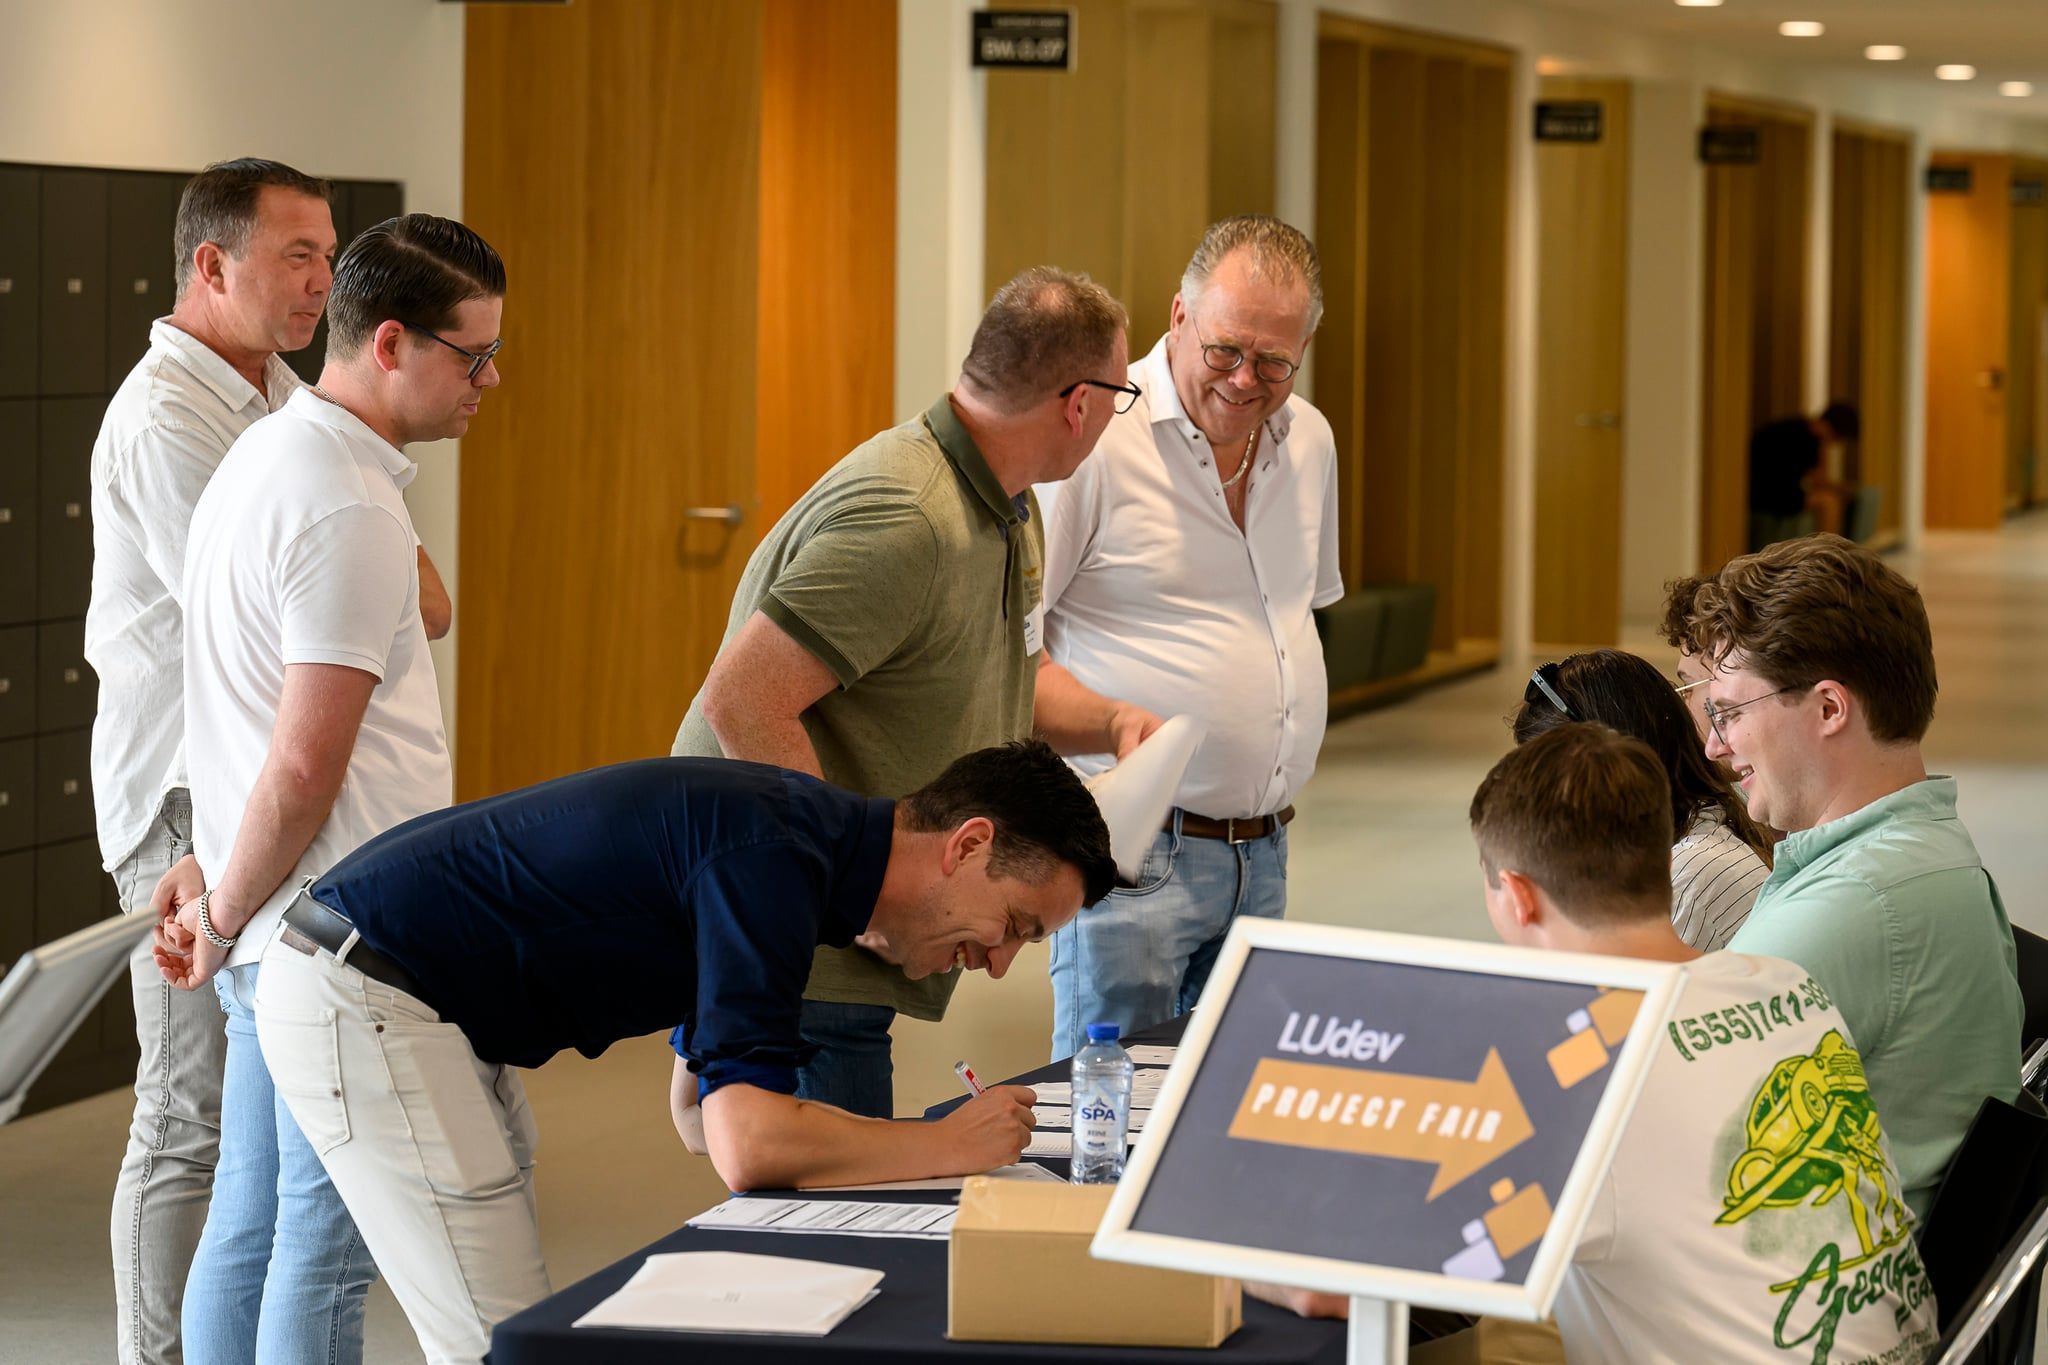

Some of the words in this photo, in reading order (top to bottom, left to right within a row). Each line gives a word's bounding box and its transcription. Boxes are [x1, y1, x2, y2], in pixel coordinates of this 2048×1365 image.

[1277, 1012, 1405, 1063] LUdev
[1082, 1107, 1116, 1121] SPA
[1251, 1083, 1406, 1130] PROJECT
[1417, 1103, 1502, 1142] FAIR
